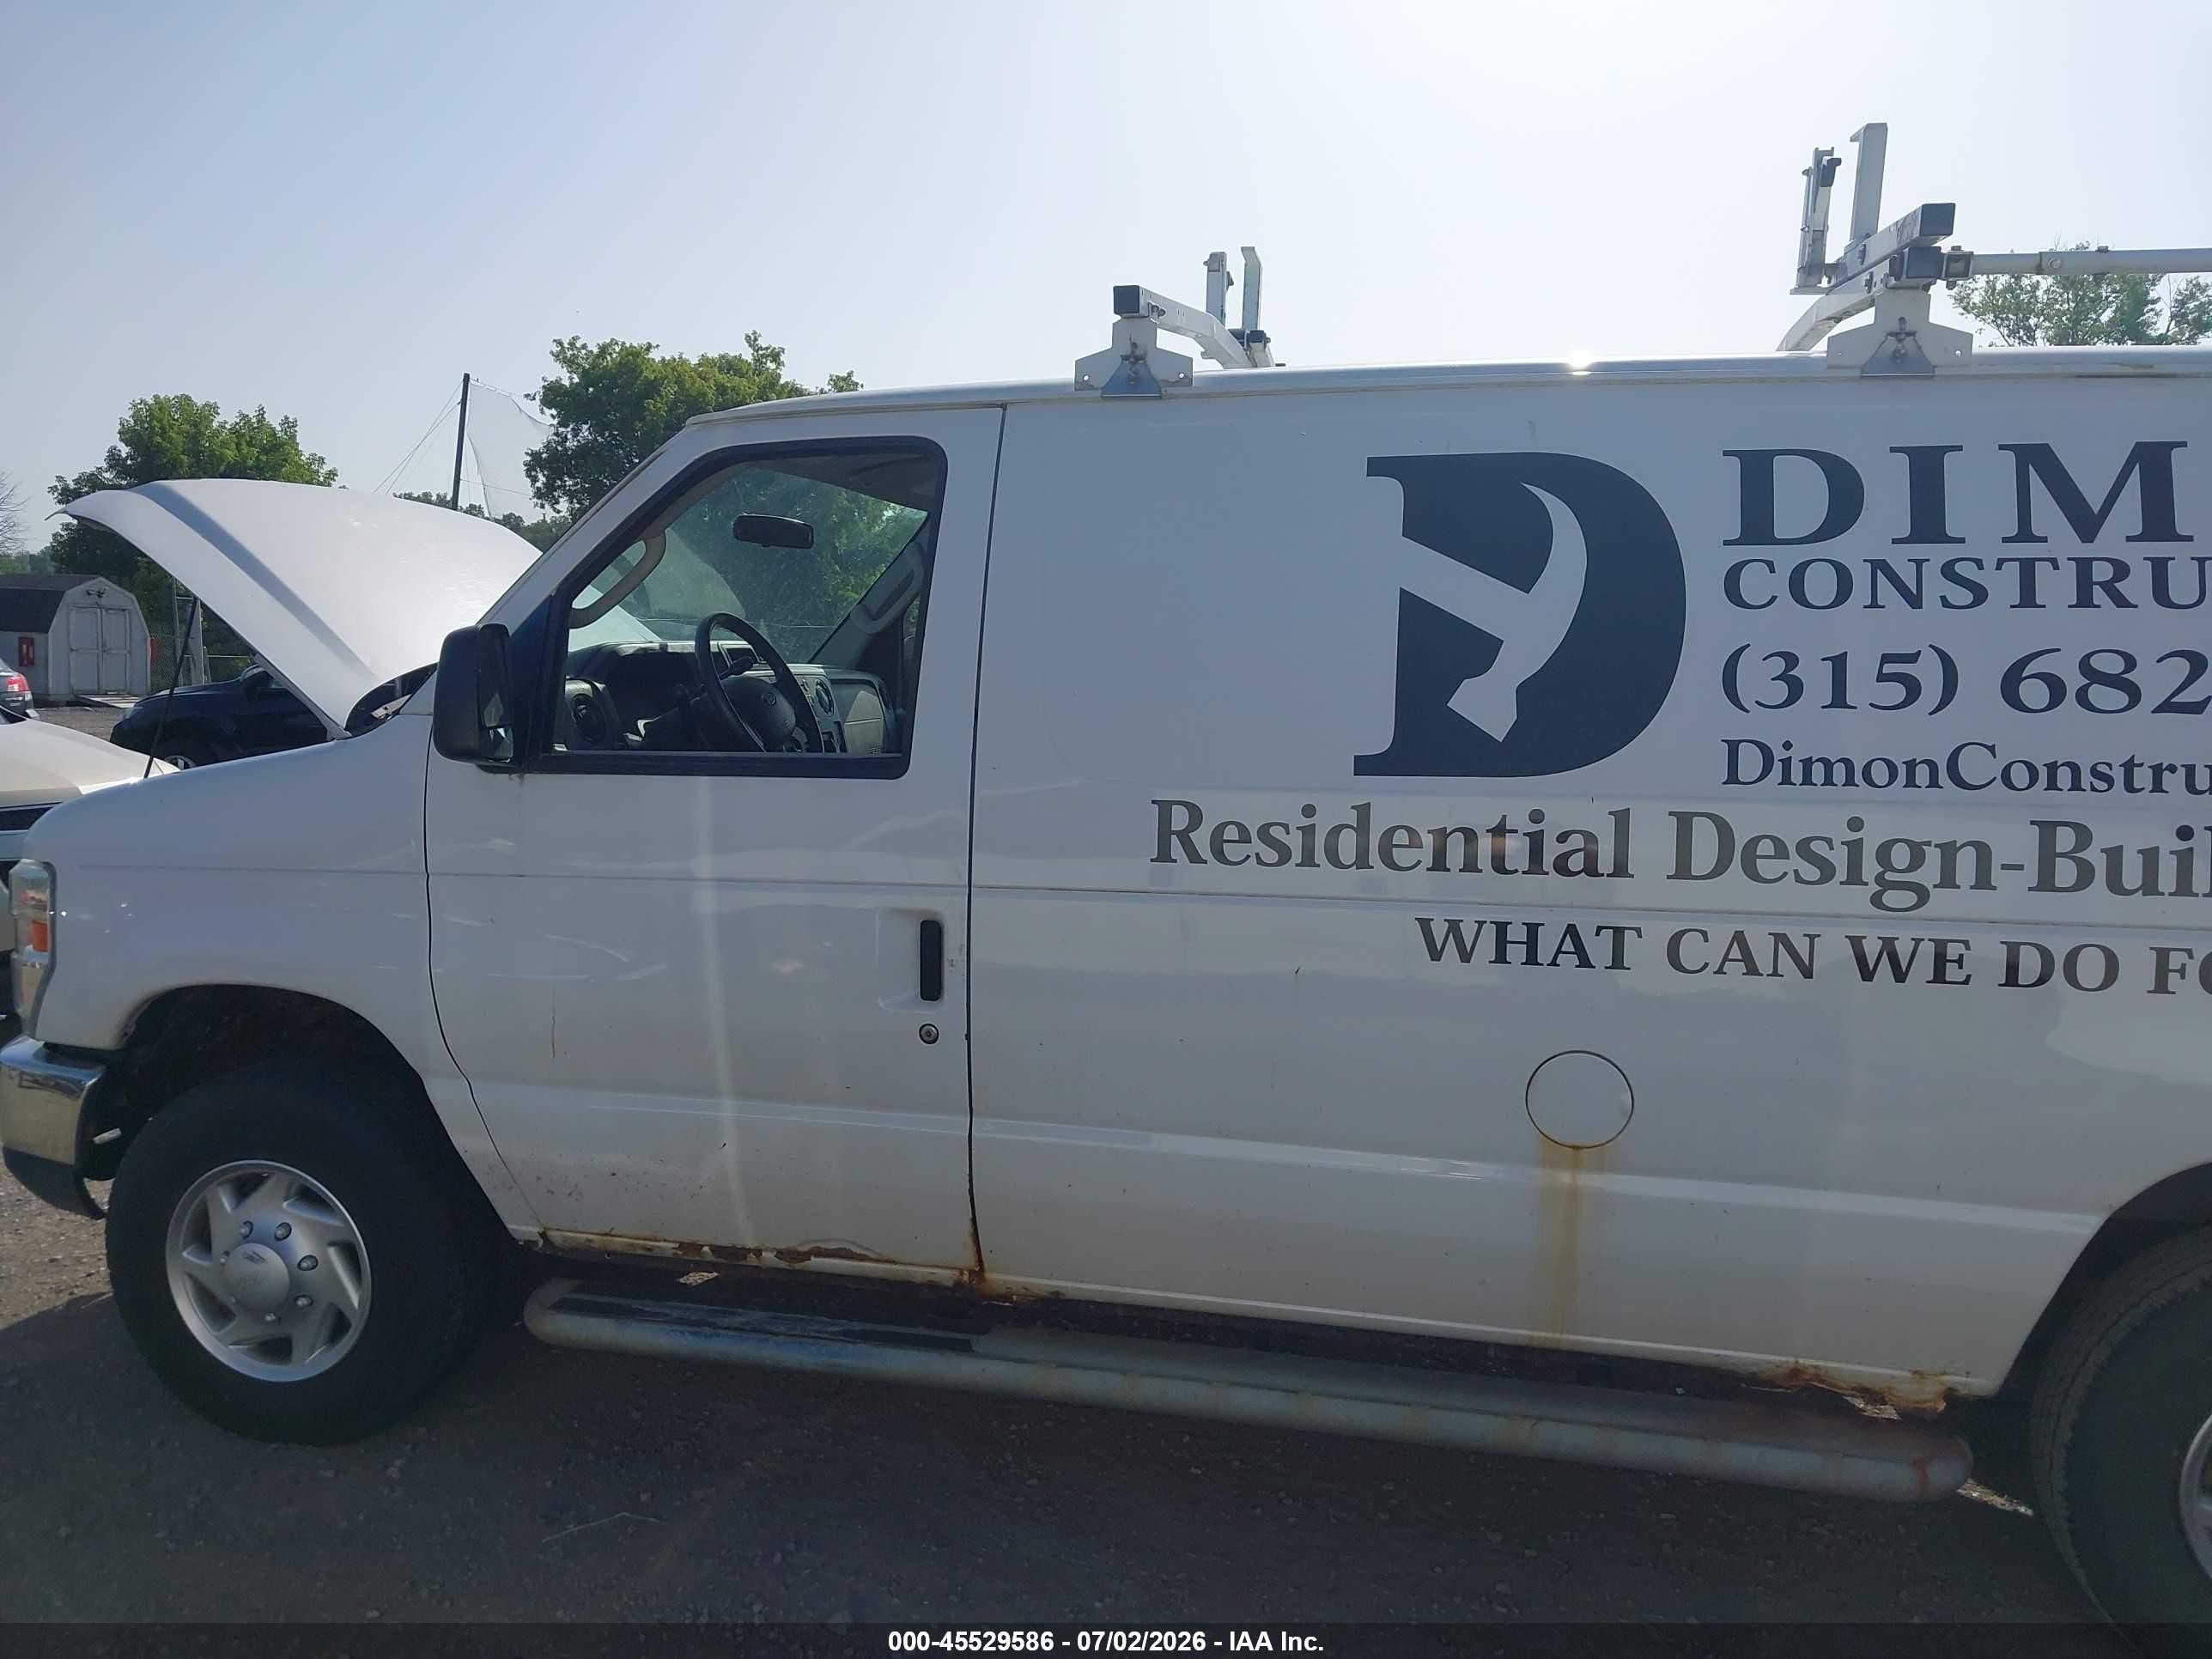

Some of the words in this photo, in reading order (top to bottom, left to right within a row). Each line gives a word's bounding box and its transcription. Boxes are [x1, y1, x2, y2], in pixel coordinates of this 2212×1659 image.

[1723, 441, 2194, 546] DIM
[1723, 556, 2212, 610] CONSTRU
[1722, 643, 1959, 715] (315)
[2000, 648, 2212, 714] 682
[1721, 738, 2212, 796] DimonConstru
[1150, 799, 1635, 879] Residential
[1414, 917, 1643, 970] WHAT
[1667, 928, 1820, 979] CAN
[1844, 935, 1972, 985] WE
[1998, 940, 2119, 992] DO
[2147, 946, 2212, 995] F
